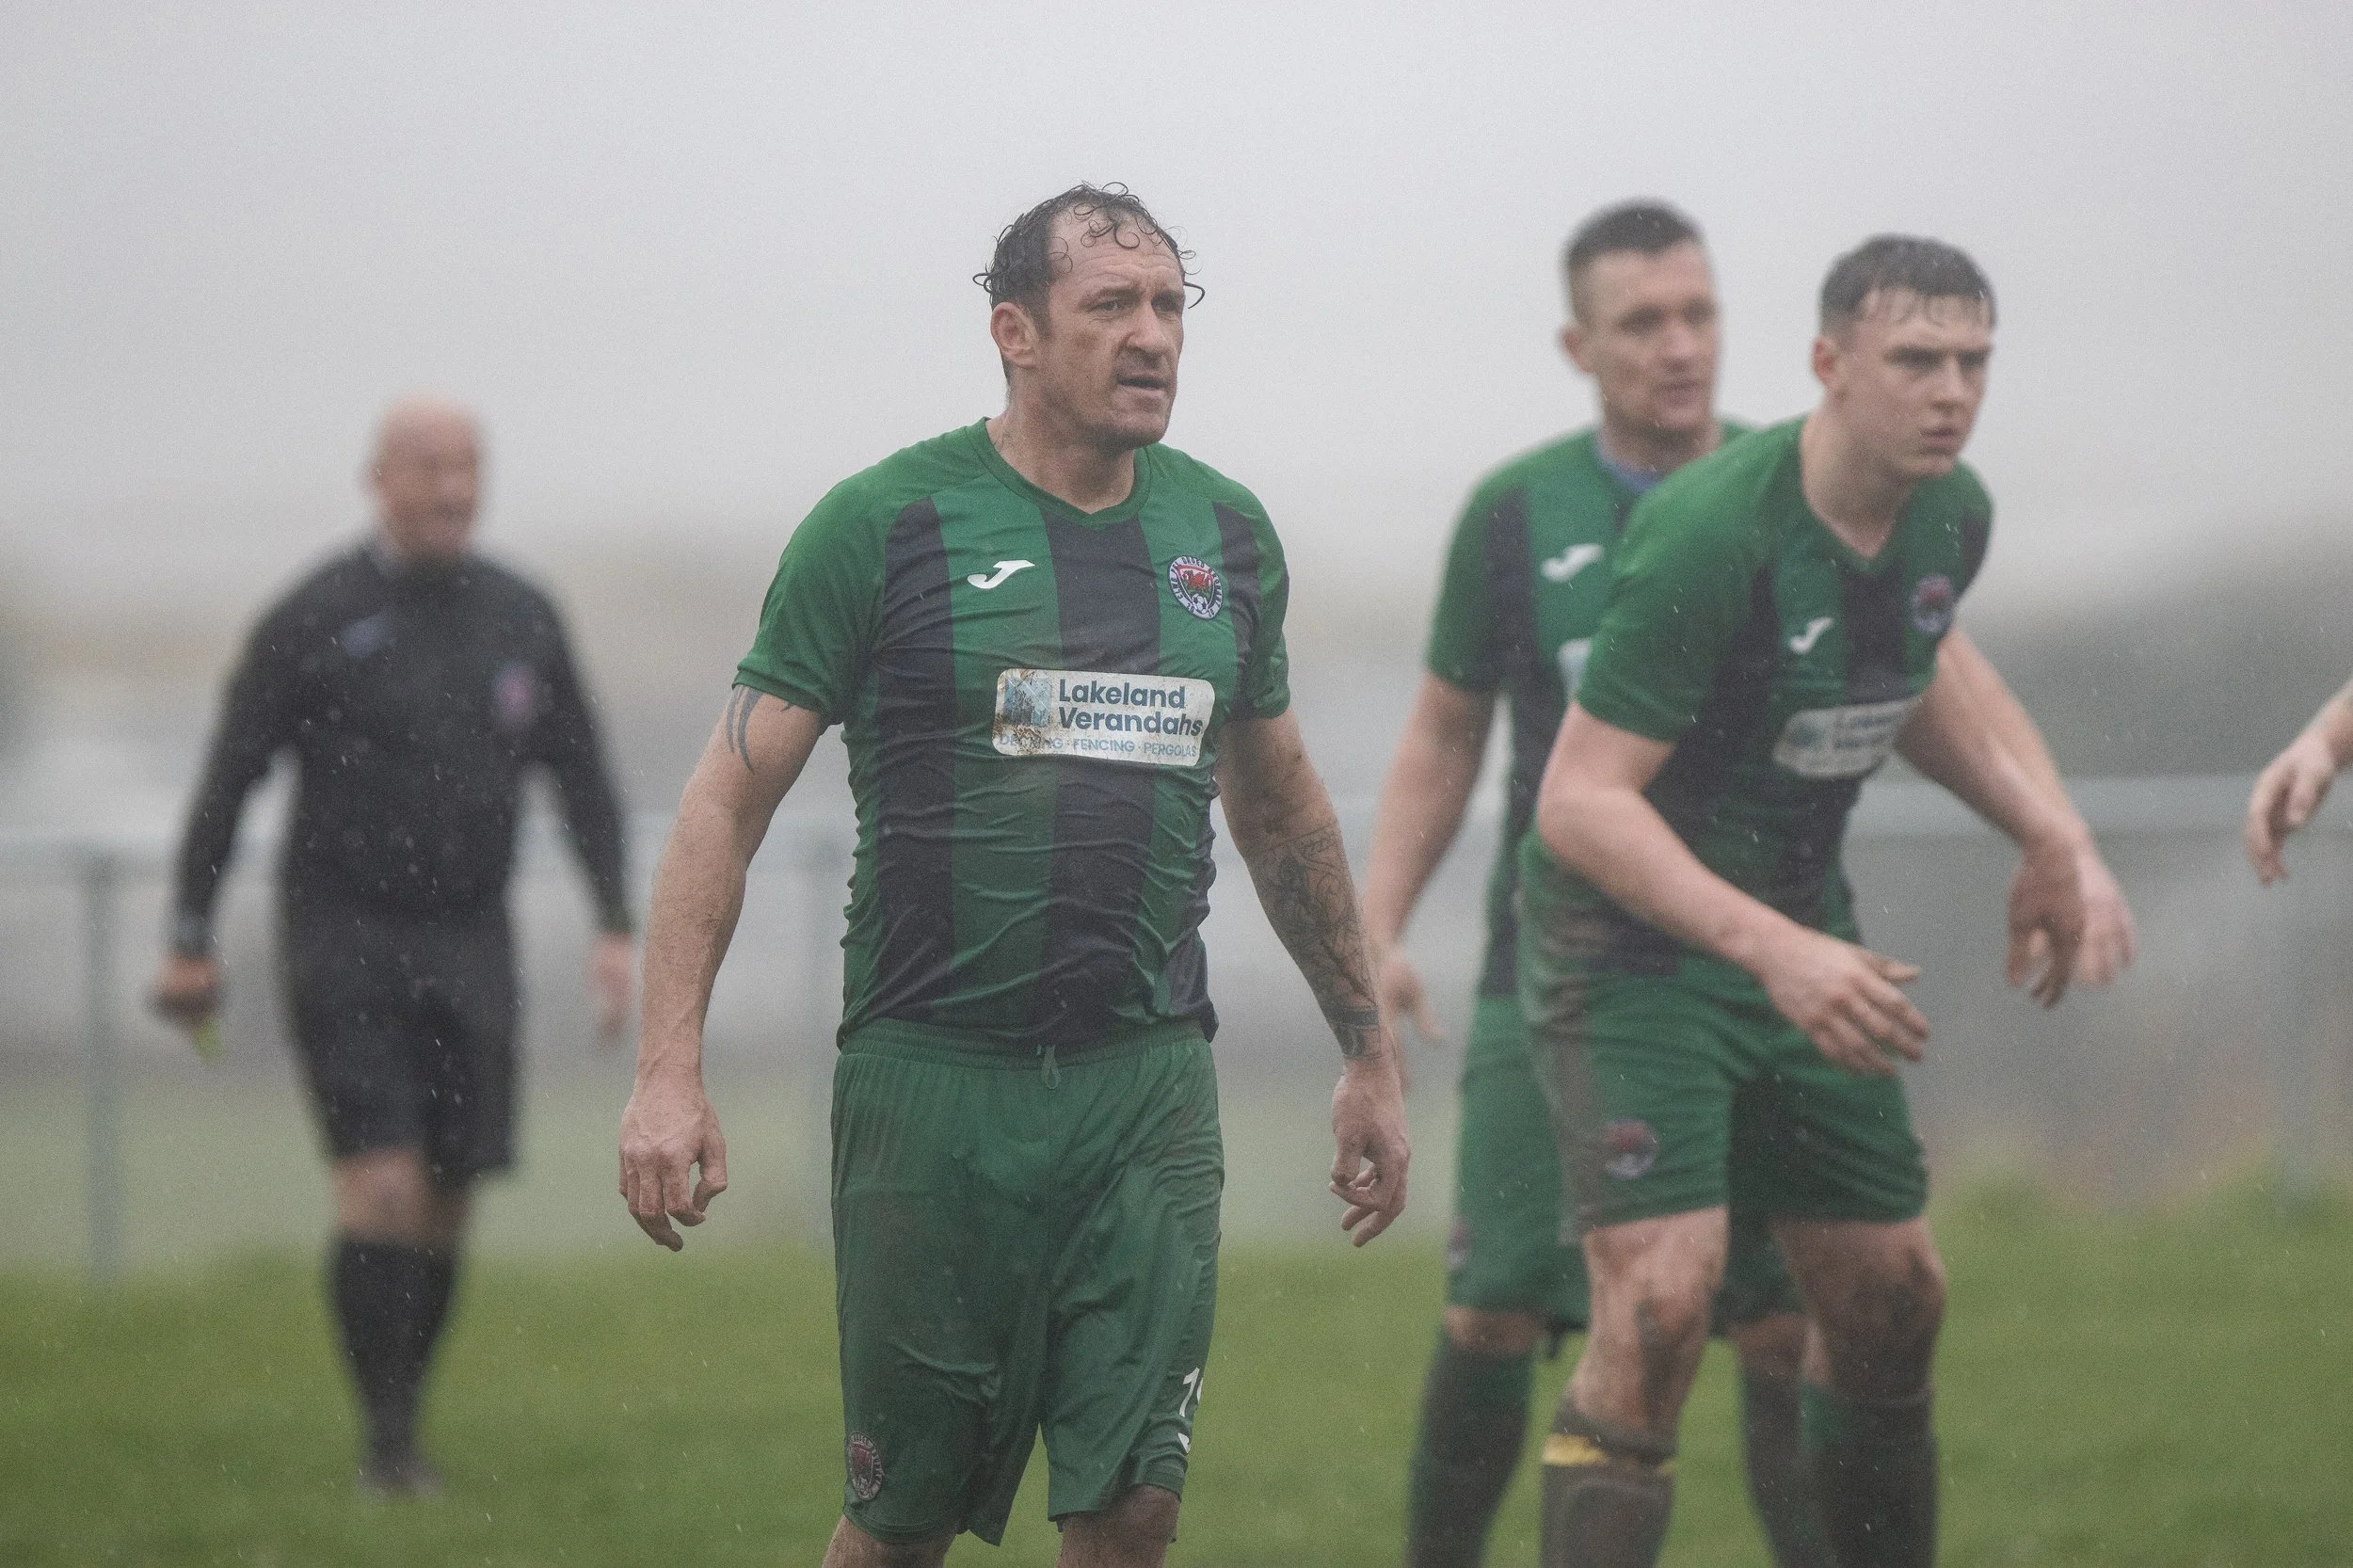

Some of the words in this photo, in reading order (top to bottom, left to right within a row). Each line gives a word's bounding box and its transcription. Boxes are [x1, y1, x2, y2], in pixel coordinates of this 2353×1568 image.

[1059, 679, 1185, 709] Lakeland
[1059, 706, 1204, 736] Verandahs
[1073, 738, 1135, 753] FENCING
